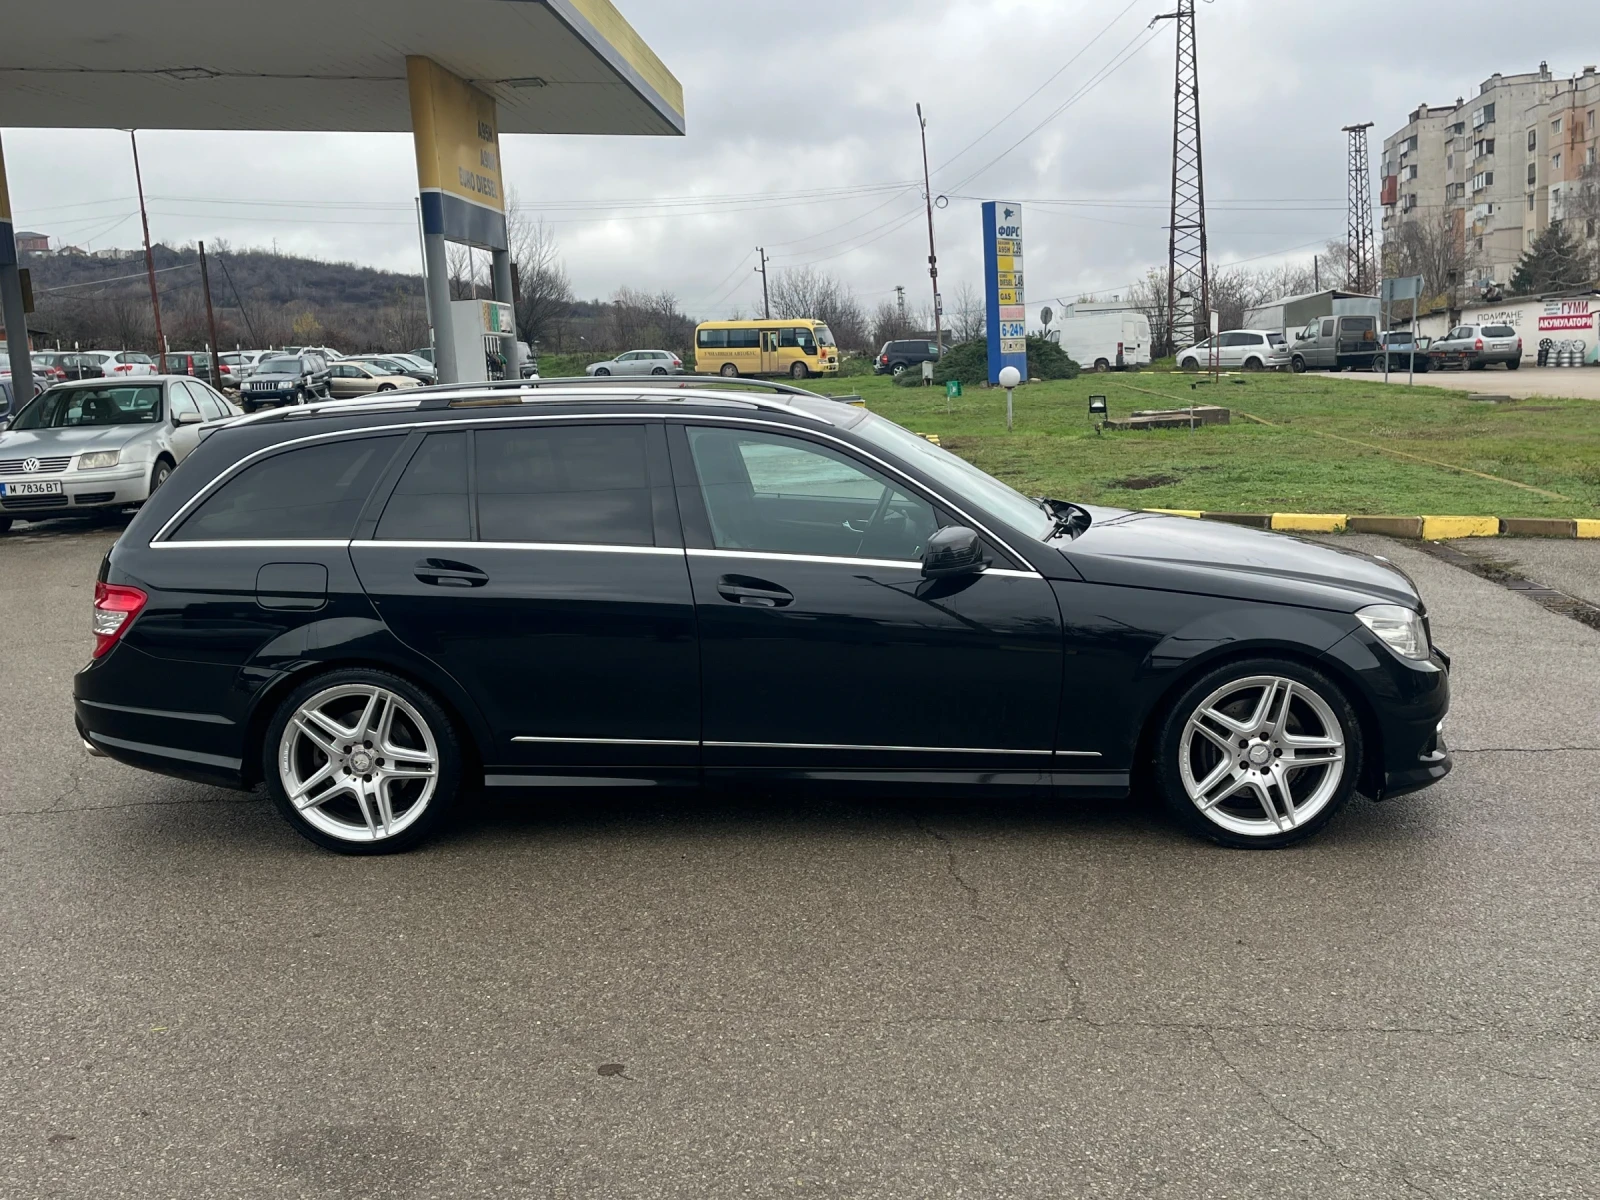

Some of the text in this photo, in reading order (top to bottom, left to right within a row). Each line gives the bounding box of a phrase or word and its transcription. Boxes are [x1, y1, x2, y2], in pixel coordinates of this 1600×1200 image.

[476, 174, 498, 199] DIESEL
[998, 226, 1020, 237] ФОРС
[1000, 278, 1014, 286] DIESEL
[1561, 301, 1589, 314] ГУМИ
[1477, 310, 1523, 322] ПОЛИРАНЕ
[1539, 317, 1593, 328] АКУМУЛАТОРИ
[20, 483, 45, 493] 7836
